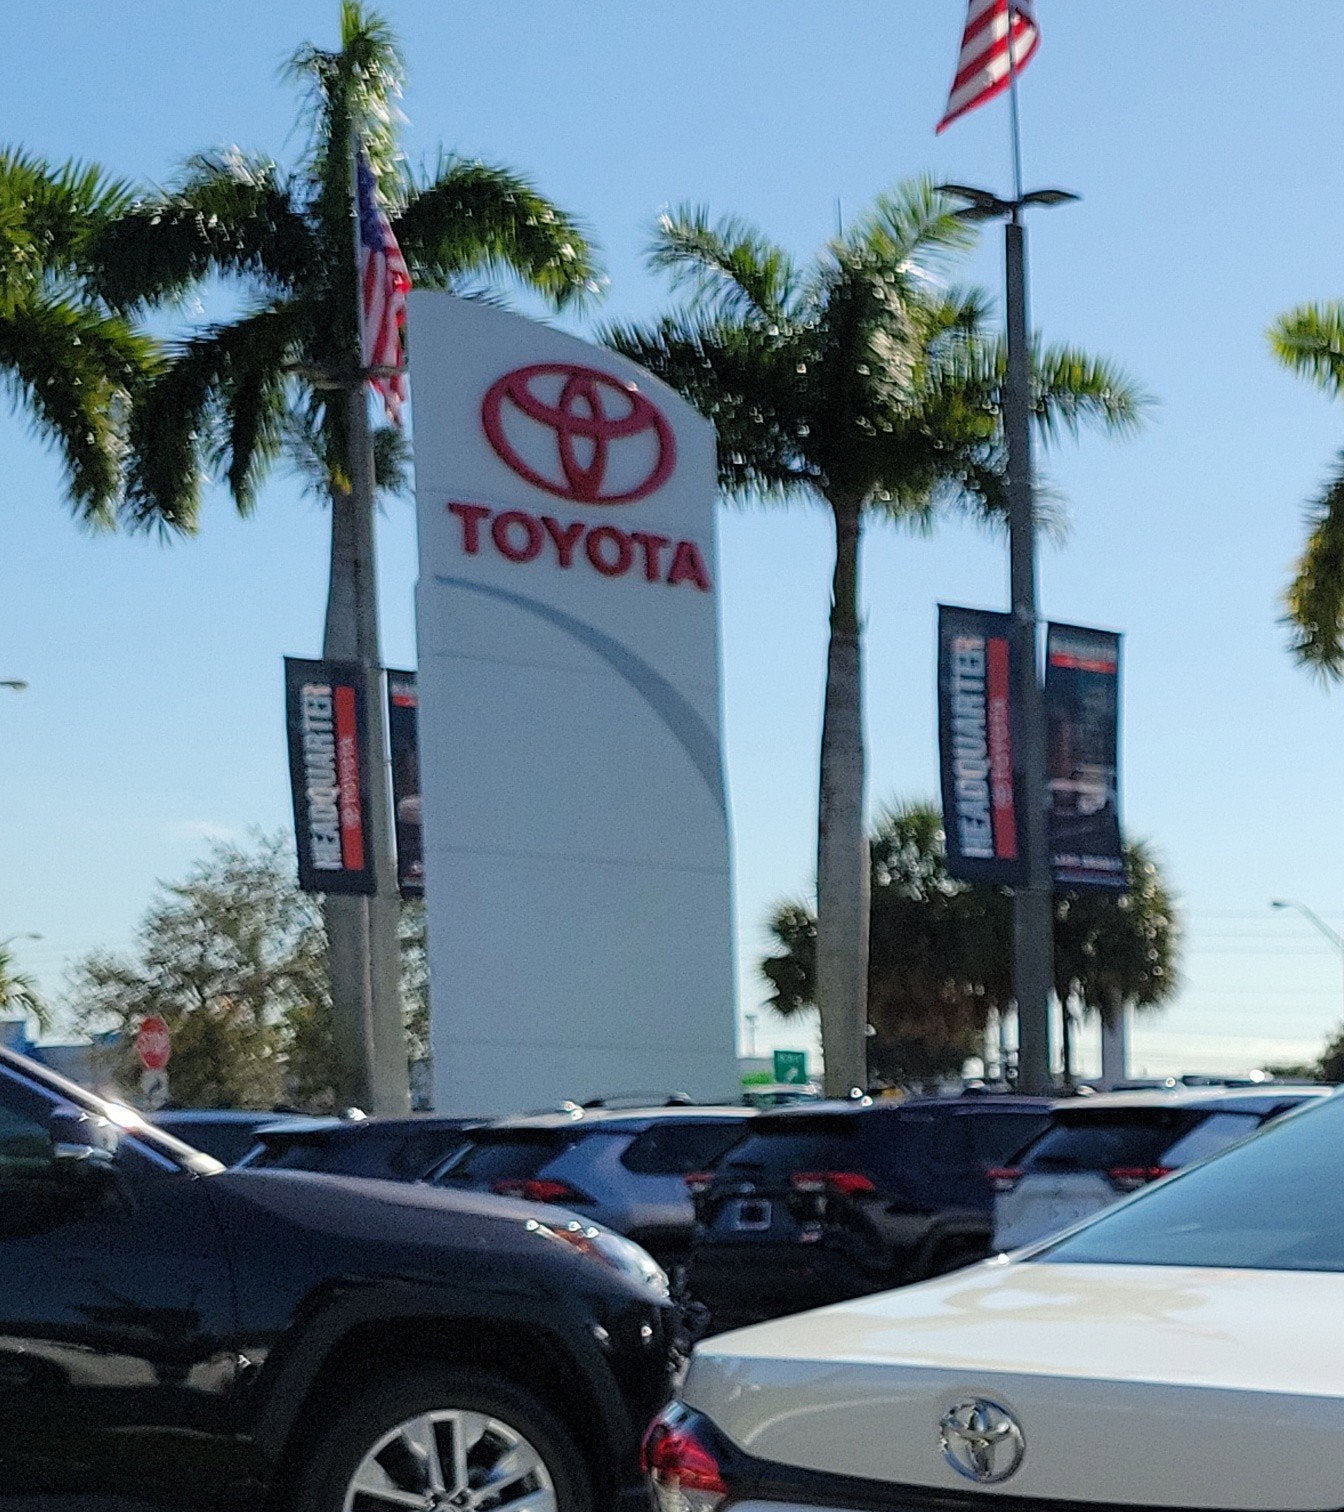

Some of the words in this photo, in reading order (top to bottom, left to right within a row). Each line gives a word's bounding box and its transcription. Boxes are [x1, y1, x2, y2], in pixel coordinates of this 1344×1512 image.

[448, 502, 710, 590] TOYOTA
[302, 683, 341, 871] HEADQUARTER
[953, 636, 994, 860] HEADQUARTER
